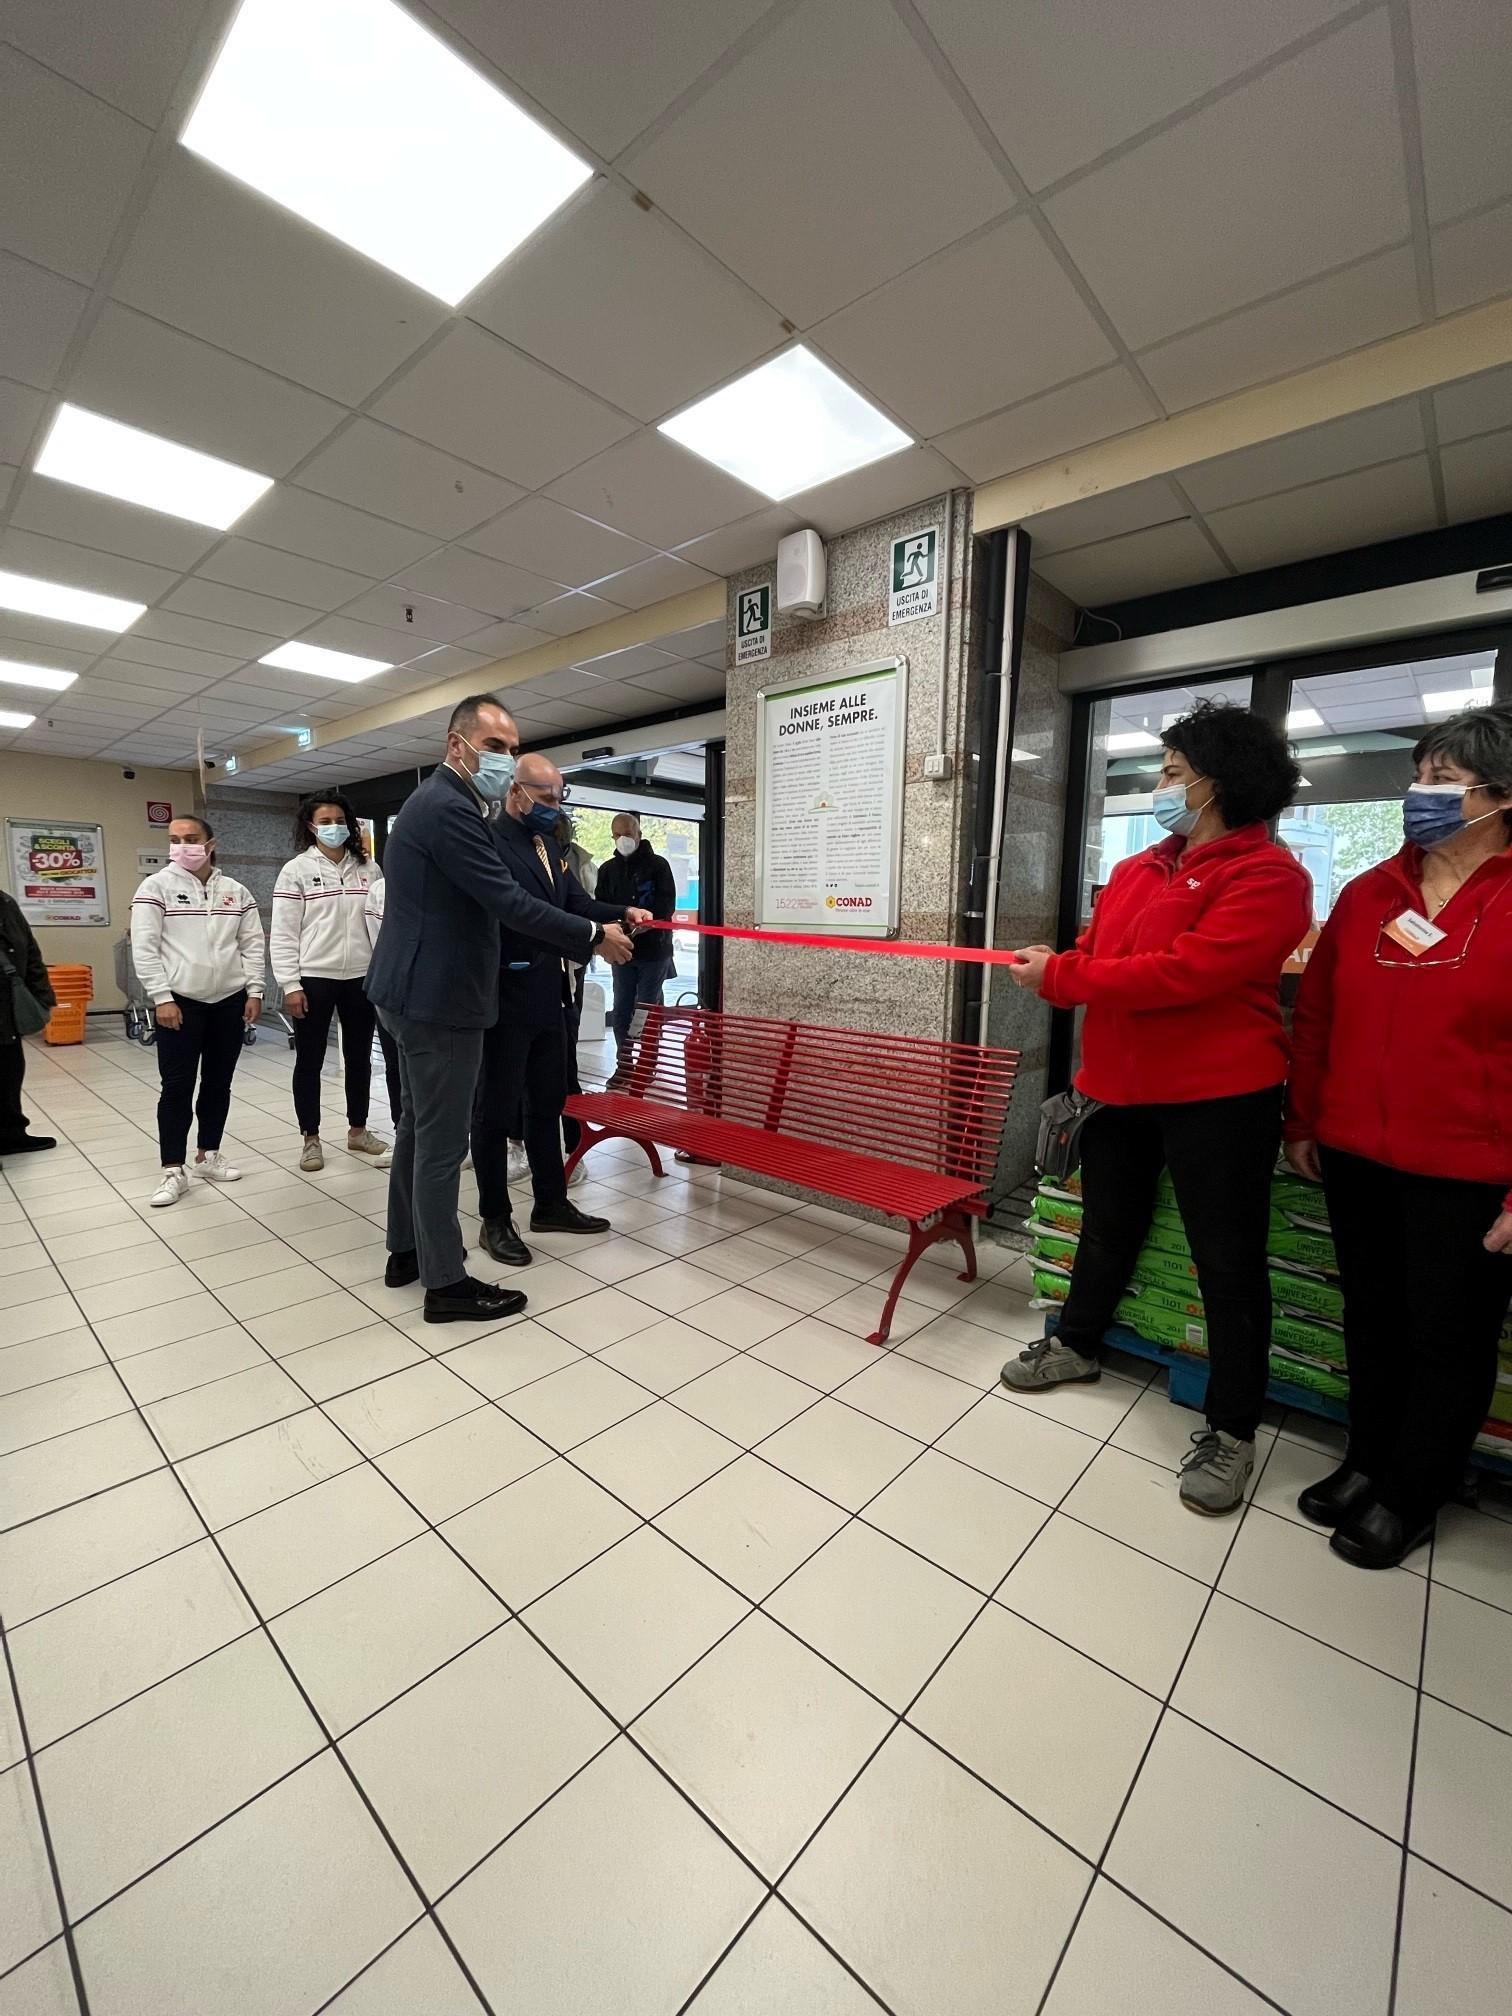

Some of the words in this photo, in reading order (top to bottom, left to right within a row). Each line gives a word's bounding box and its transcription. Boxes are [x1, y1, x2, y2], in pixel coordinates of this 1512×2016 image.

[896, 591, 919, 607] USCITA
[921, 588, 929, 600] DI
[892, 601, 932, 621] EMERGENZA
[741, 637, 758, 649] USCITA
[759, 635, 765, 644] DI
[738, 646, 768, 661] EMERGENZA
[790, 699, 836, 719] INSIEME
[839, 693, 866, 710] ALLE
[779, 718, 824, 736] DONNE,
[828, 708, 878, 728] SEMPRE.
[31, 852, 81, 869] -30%
[776, 898, 798, 909] 1522
[836, 897, 872, 907] CONAD
[1277, 1287, 1329, 1306] UNIVERSALE
